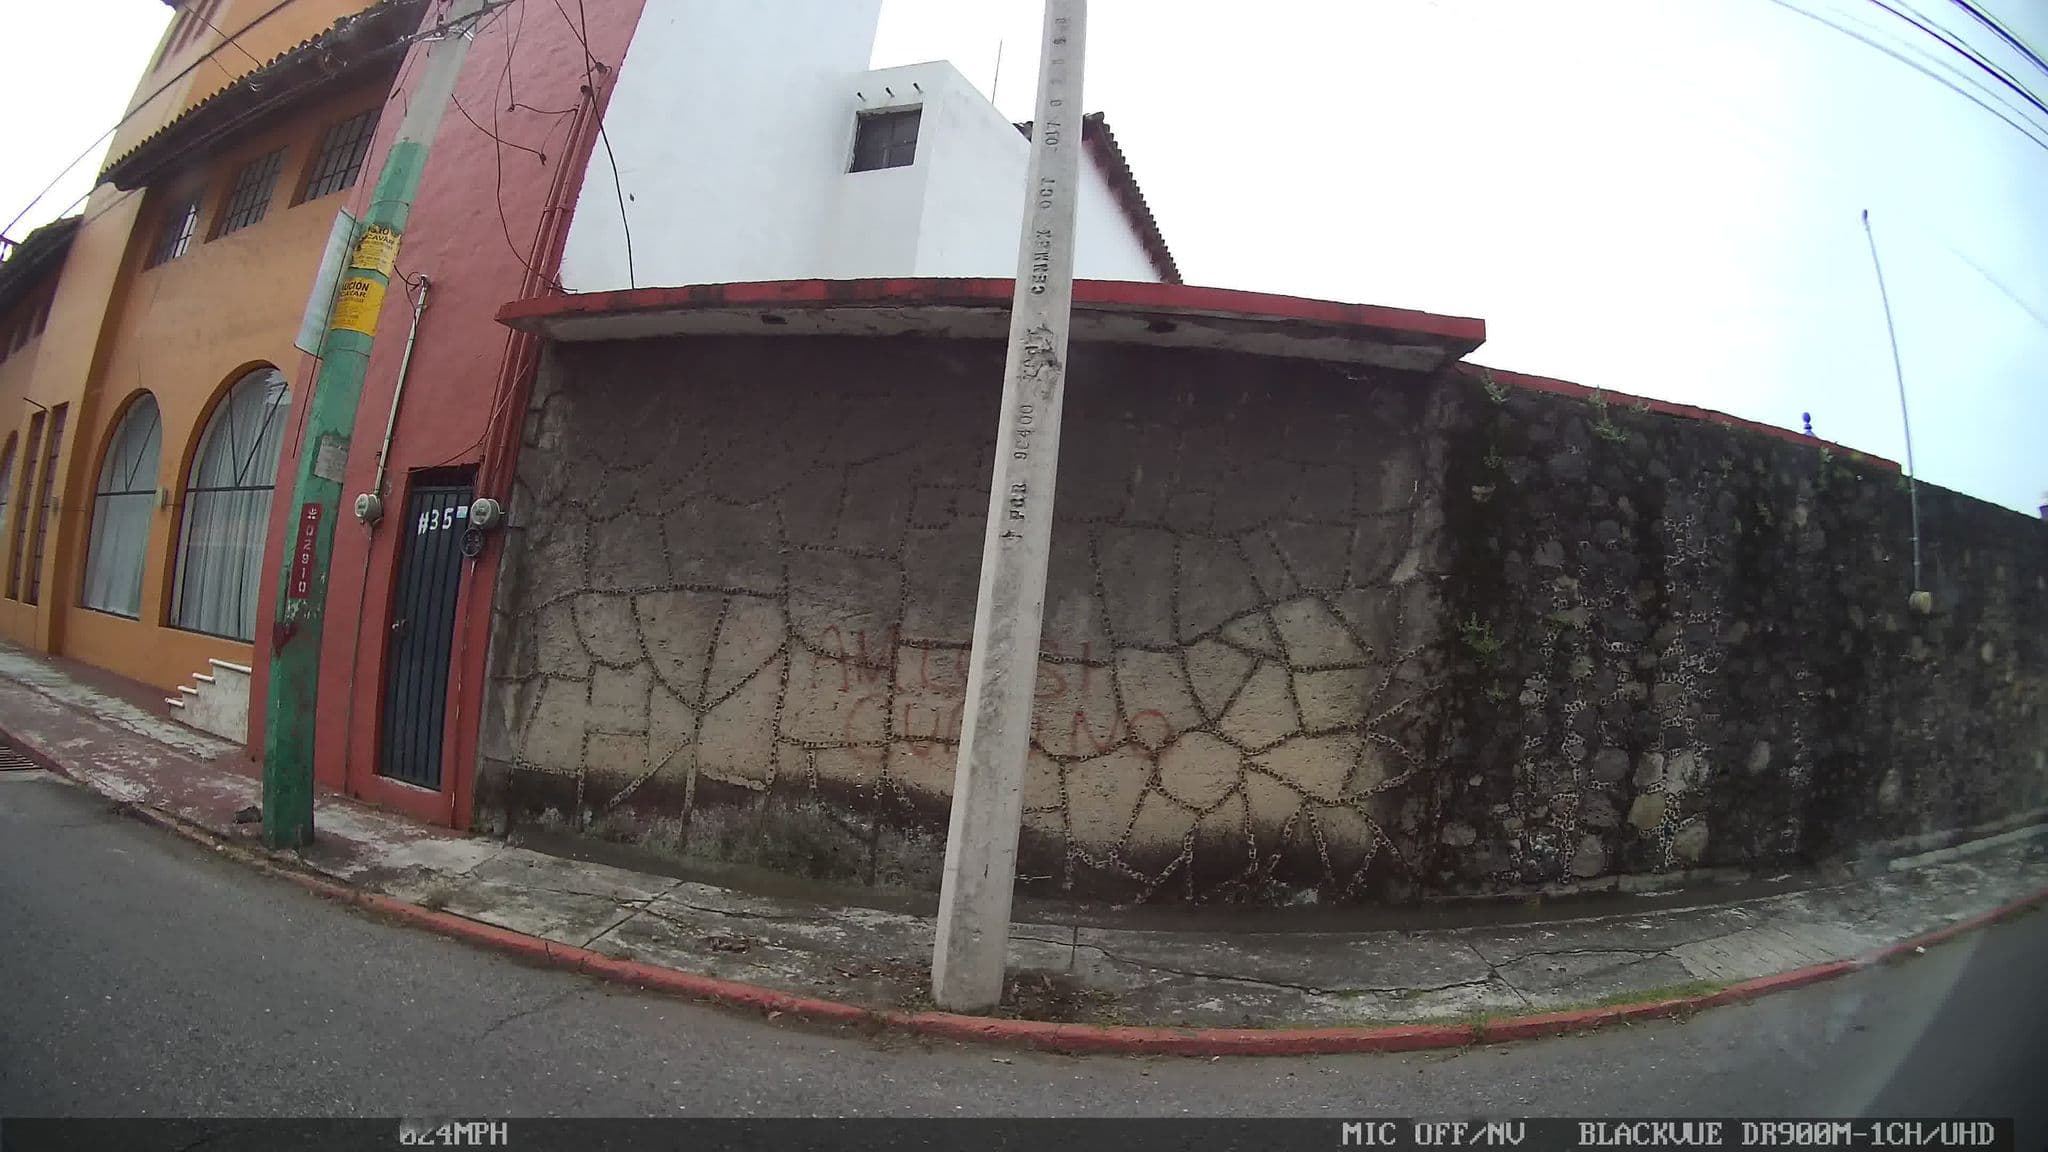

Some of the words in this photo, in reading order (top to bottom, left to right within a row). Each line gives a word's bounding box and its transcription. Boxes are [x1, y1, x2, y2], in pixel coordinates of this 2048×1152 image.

[1044, 120, 1061, 152] 017
[1038, 176, 1056, 210] OCT
[417, 507, 455, 537] #35
